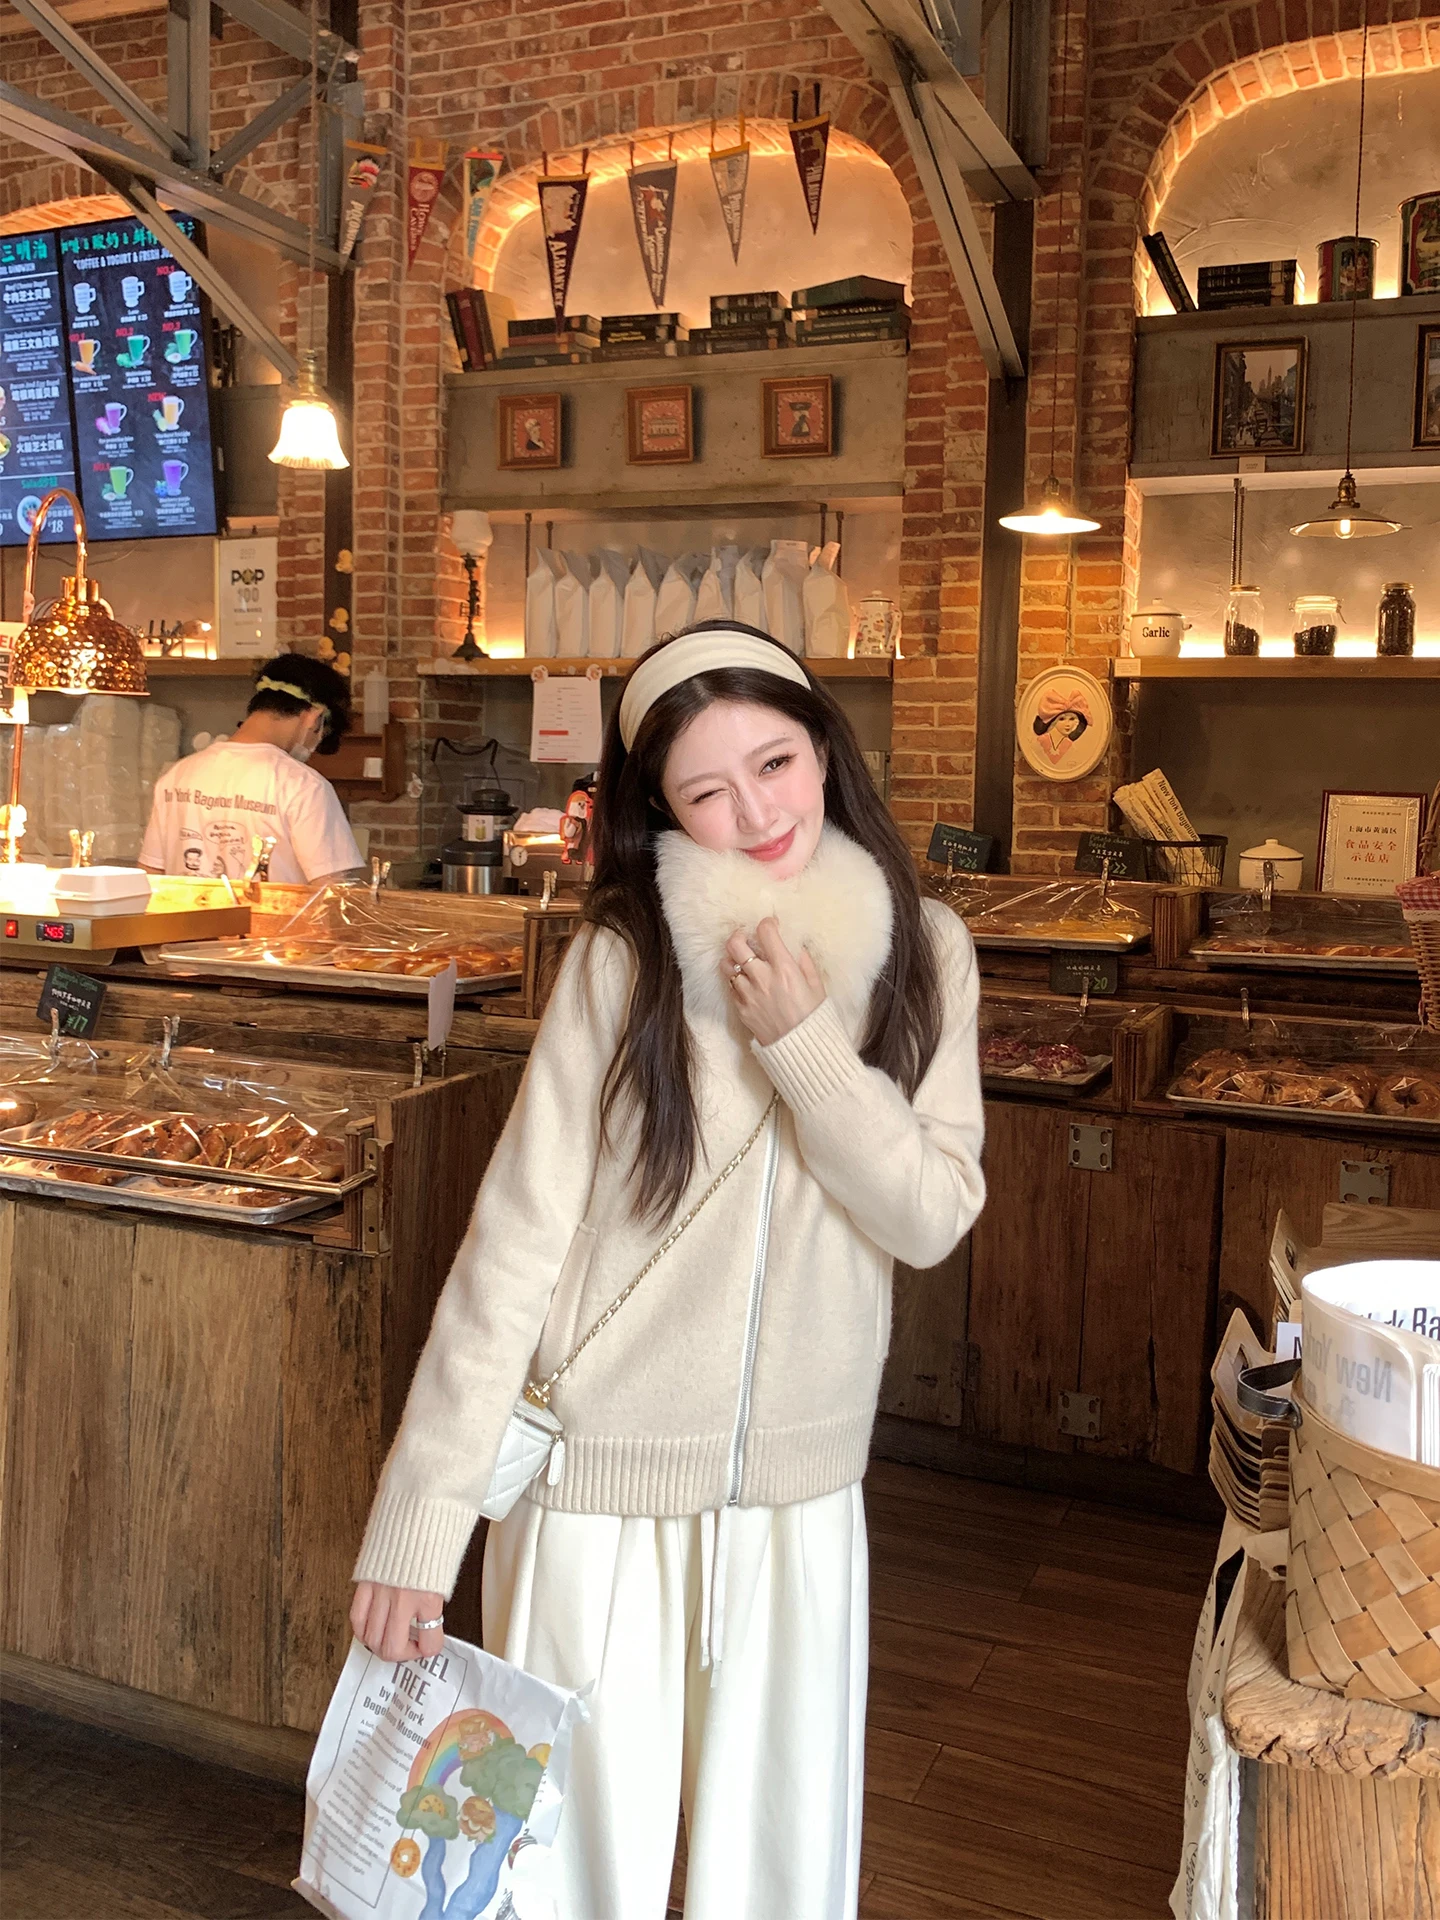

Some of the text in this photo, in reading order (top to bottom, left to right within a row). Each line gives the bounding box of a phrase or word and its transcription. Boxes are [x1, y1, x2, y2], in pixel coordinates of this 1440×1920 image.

[548, 240, 568, 292] ALBANY
[1142, 626, 1171, 639] Garlic
[1158, 780, 1171, 797] New
[234, 794, 277, 816] Museum
[1346, 839, 1397, 851] 食品安全
[1351, 852, 1390, 863] 示范店
[391, 1661, 431, 1706] TREE
[379, 1686, 425, 1726] by New York
[396, 1719, 431, 1750] Museum
